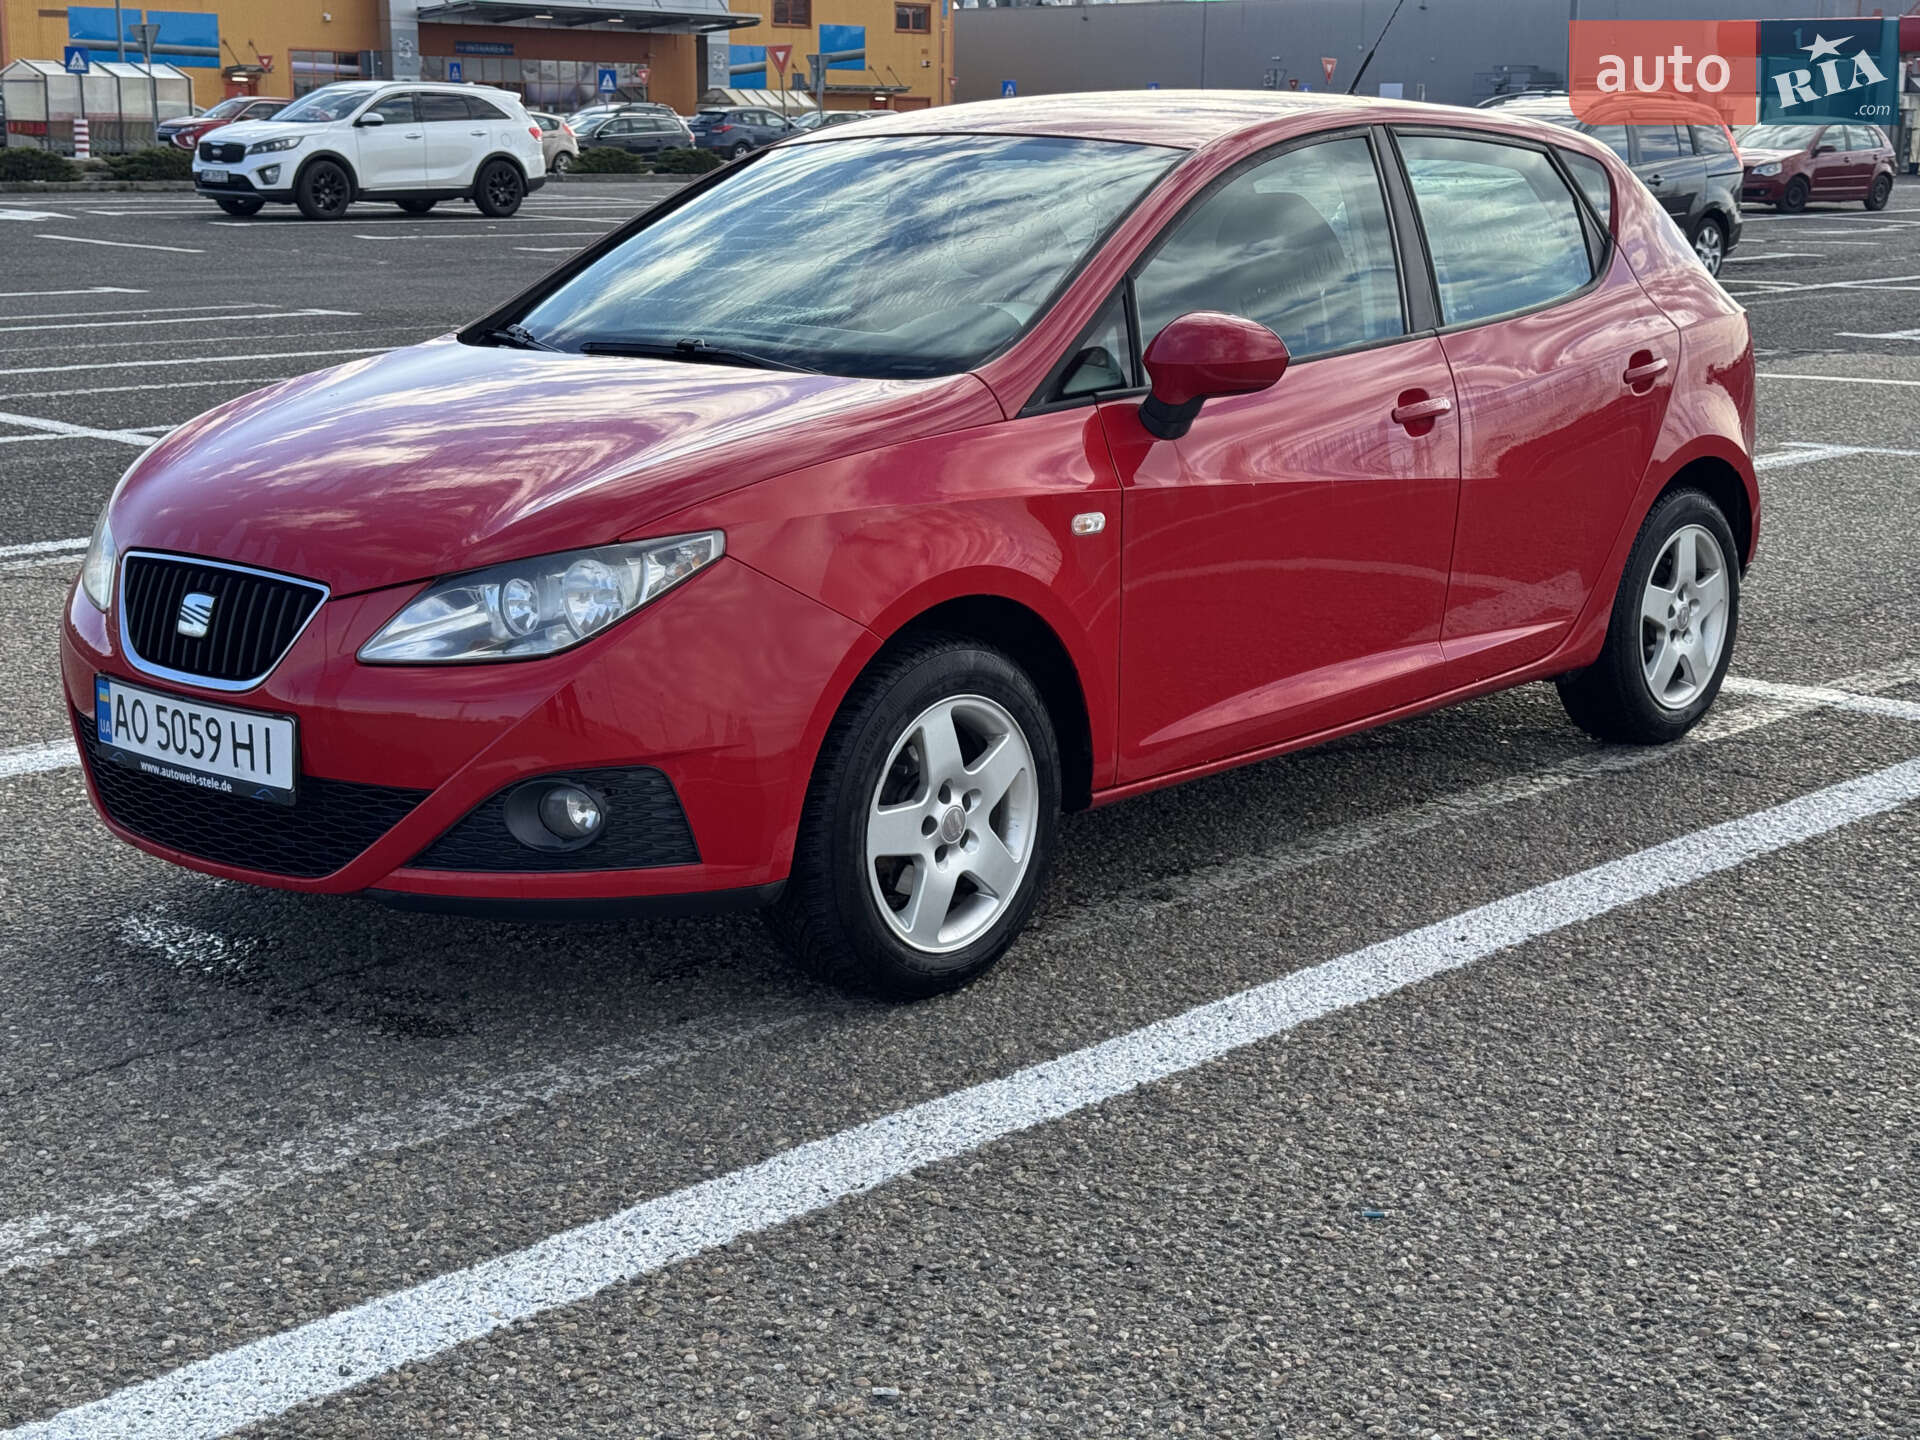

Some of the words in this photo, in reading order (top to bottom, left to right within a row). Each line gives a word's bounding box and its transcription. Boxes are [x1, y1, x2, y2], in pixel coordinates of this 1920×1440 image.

[100, 718, 111, 735] UA
[115, 694, 148, 744] AO
[155, 704, 222, 763] 5059
[230, 721, 271, 775] HI
[140, 760, 233, 793] www.autowelt-stele.de
